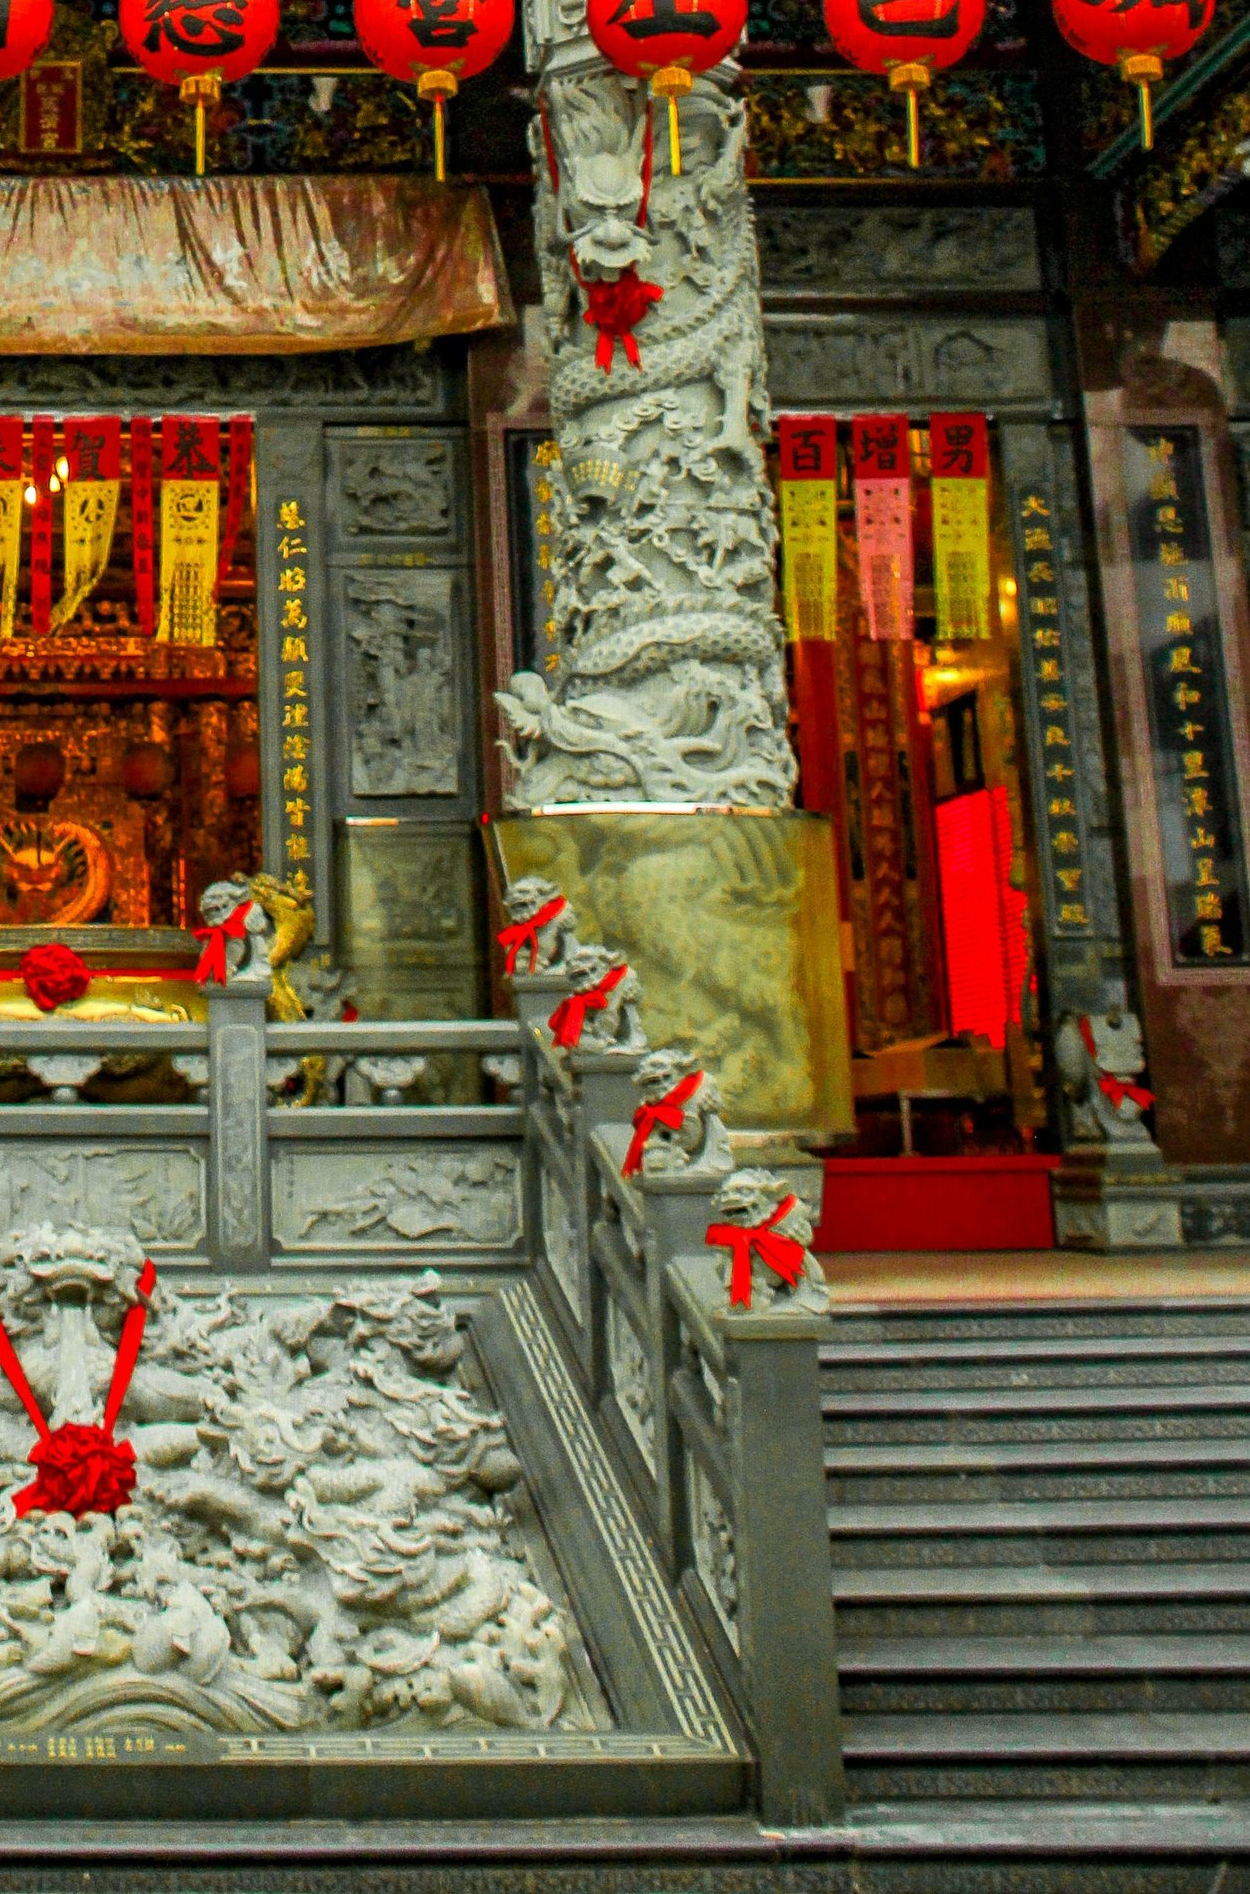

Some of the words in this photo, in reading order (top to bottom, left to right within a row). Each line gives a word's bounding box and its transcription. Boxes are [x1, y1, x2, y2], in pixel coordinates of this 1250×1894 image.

[71, 431, 107, 481] 賀
[165, 422, 218, 480] 恭
[789, 428, 826, 474] 百
[859, 424, 899, 472] 增
[940, 425, 976, 474] 男
